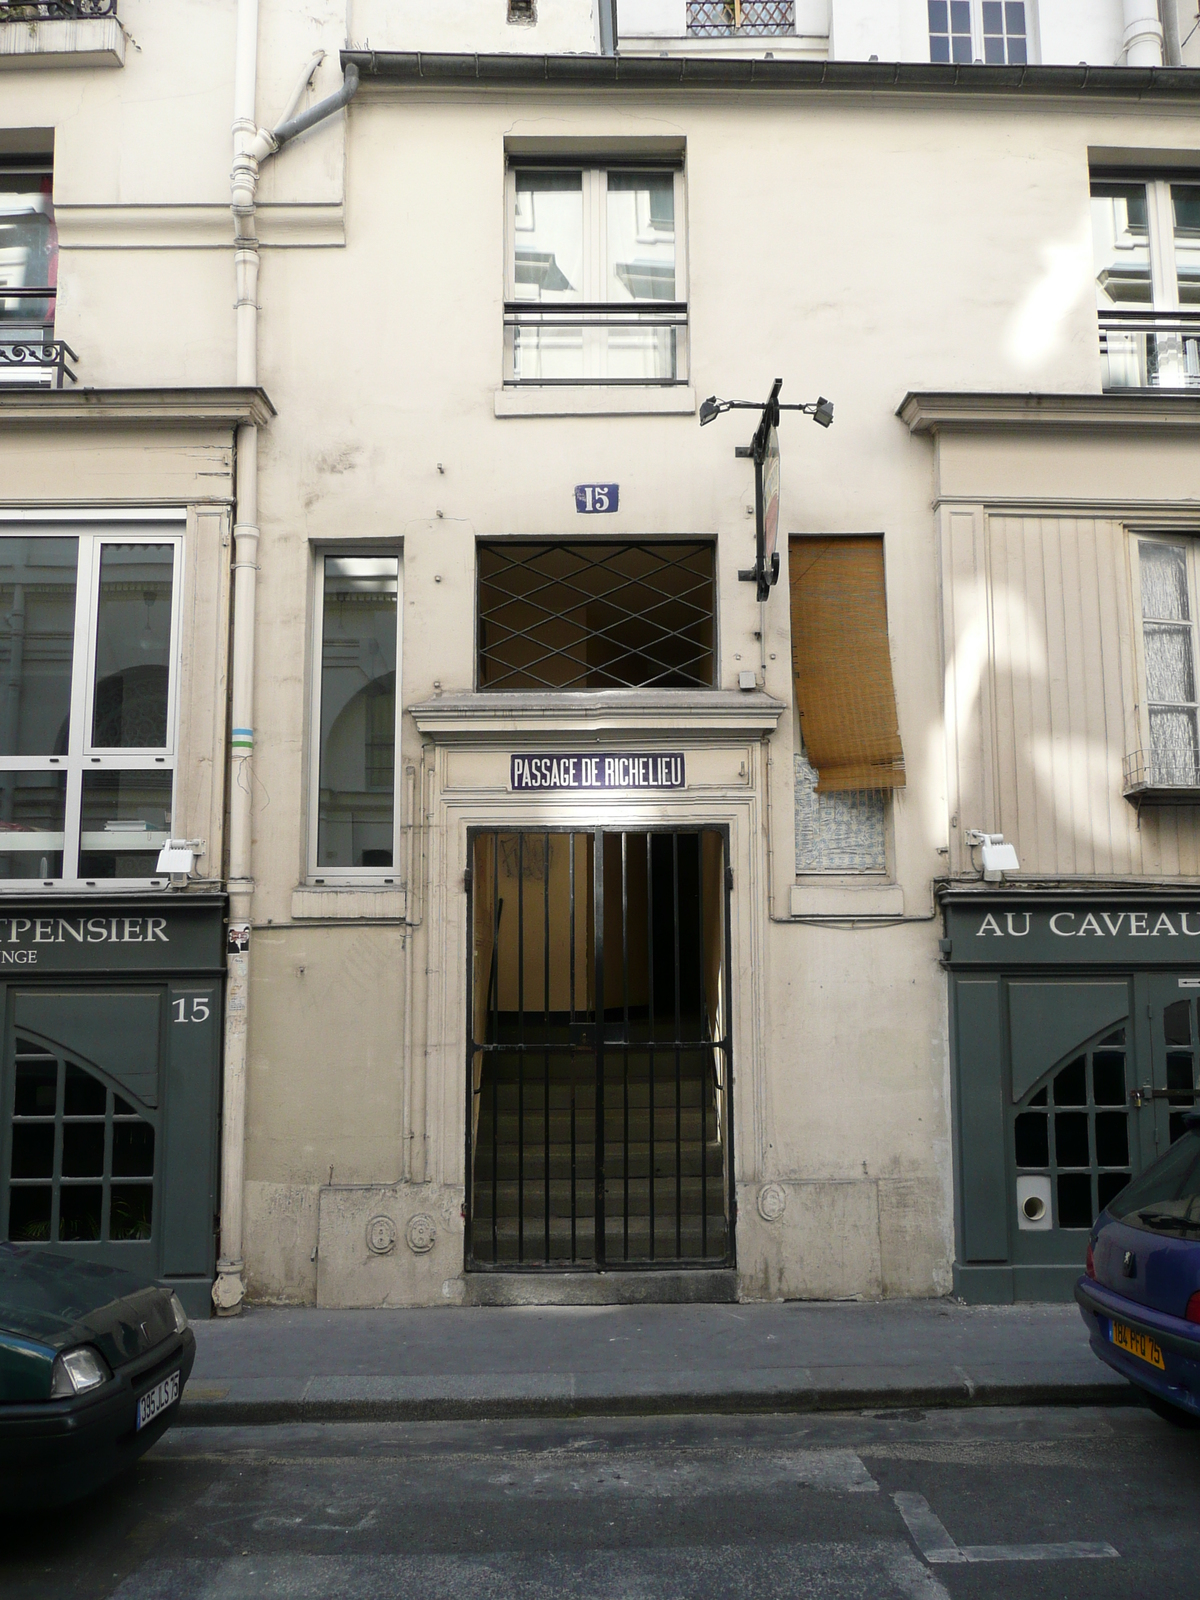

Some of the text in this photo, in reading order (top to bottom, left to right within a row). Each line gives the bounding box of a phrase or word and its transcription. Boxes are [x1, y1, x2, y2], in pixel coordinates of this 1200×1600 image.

[584, 487, 609, 511] 15
[514, 757, 681, 787] PASSAGE DE RICHELIEU
[976, 912, 1200, 936] AU CAVEAU
[0, 950, 37, 964] NGE
[172, 998, 210, 1023] 15
[1148, 1335, 1160, 1364] 75
[141, 1373, 179, 1422] 395 JLS 75
